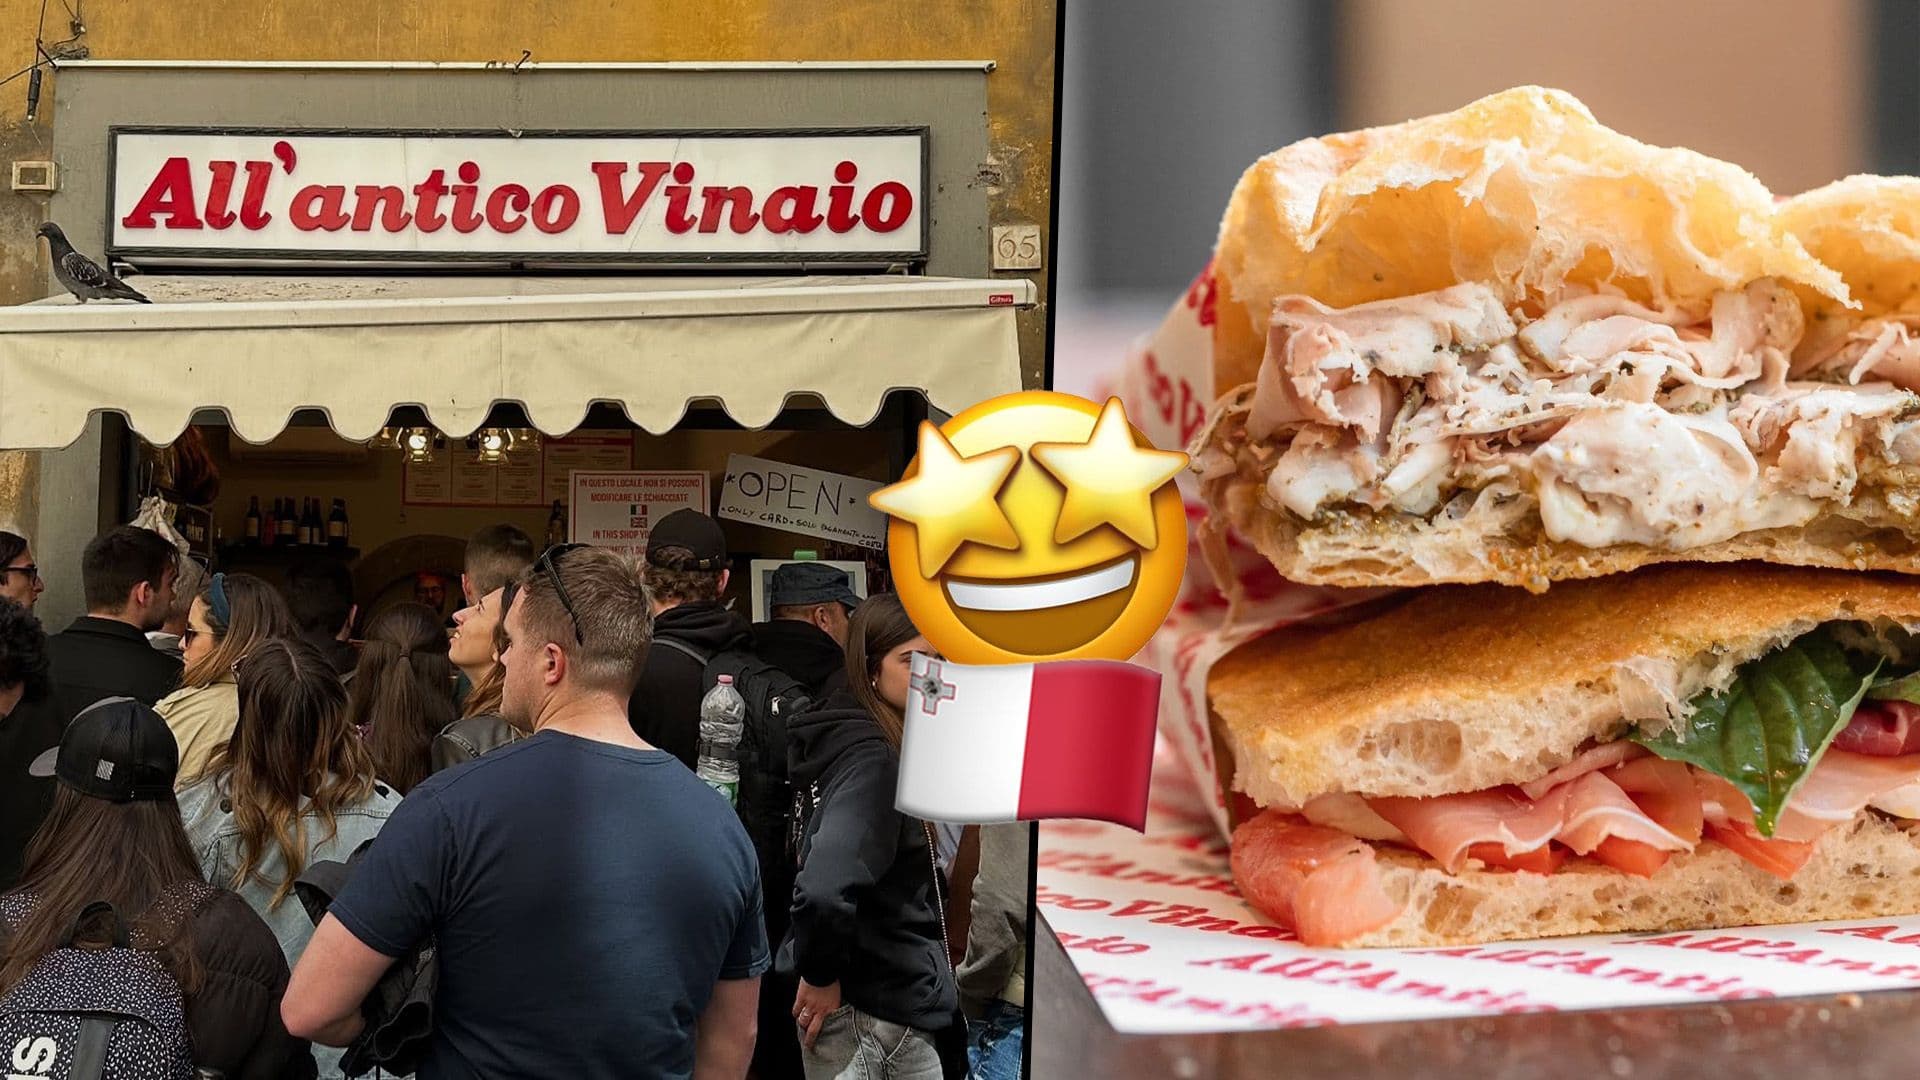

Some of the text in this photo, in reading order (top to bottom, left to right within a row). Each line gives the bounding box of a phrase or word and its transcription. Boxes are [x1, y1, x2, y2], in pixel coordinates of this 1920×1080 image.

[123, 141, 913, 235] All'antico Vinaio
[998, 230, 1037, 259] 65
[579, 479, 700, 488] IN QUESTO LOCALE NON SI POSSONO
[591, 493, 689, 502] MODIFICARE LE SCHIACCIATE
[739, 472, 843, 516] OPEN
[759, 513, 788, 525] CARD
[592, 530, 650, 539] IN THIS SHOP YO
[1108, 900, 1299, 941] Vina
